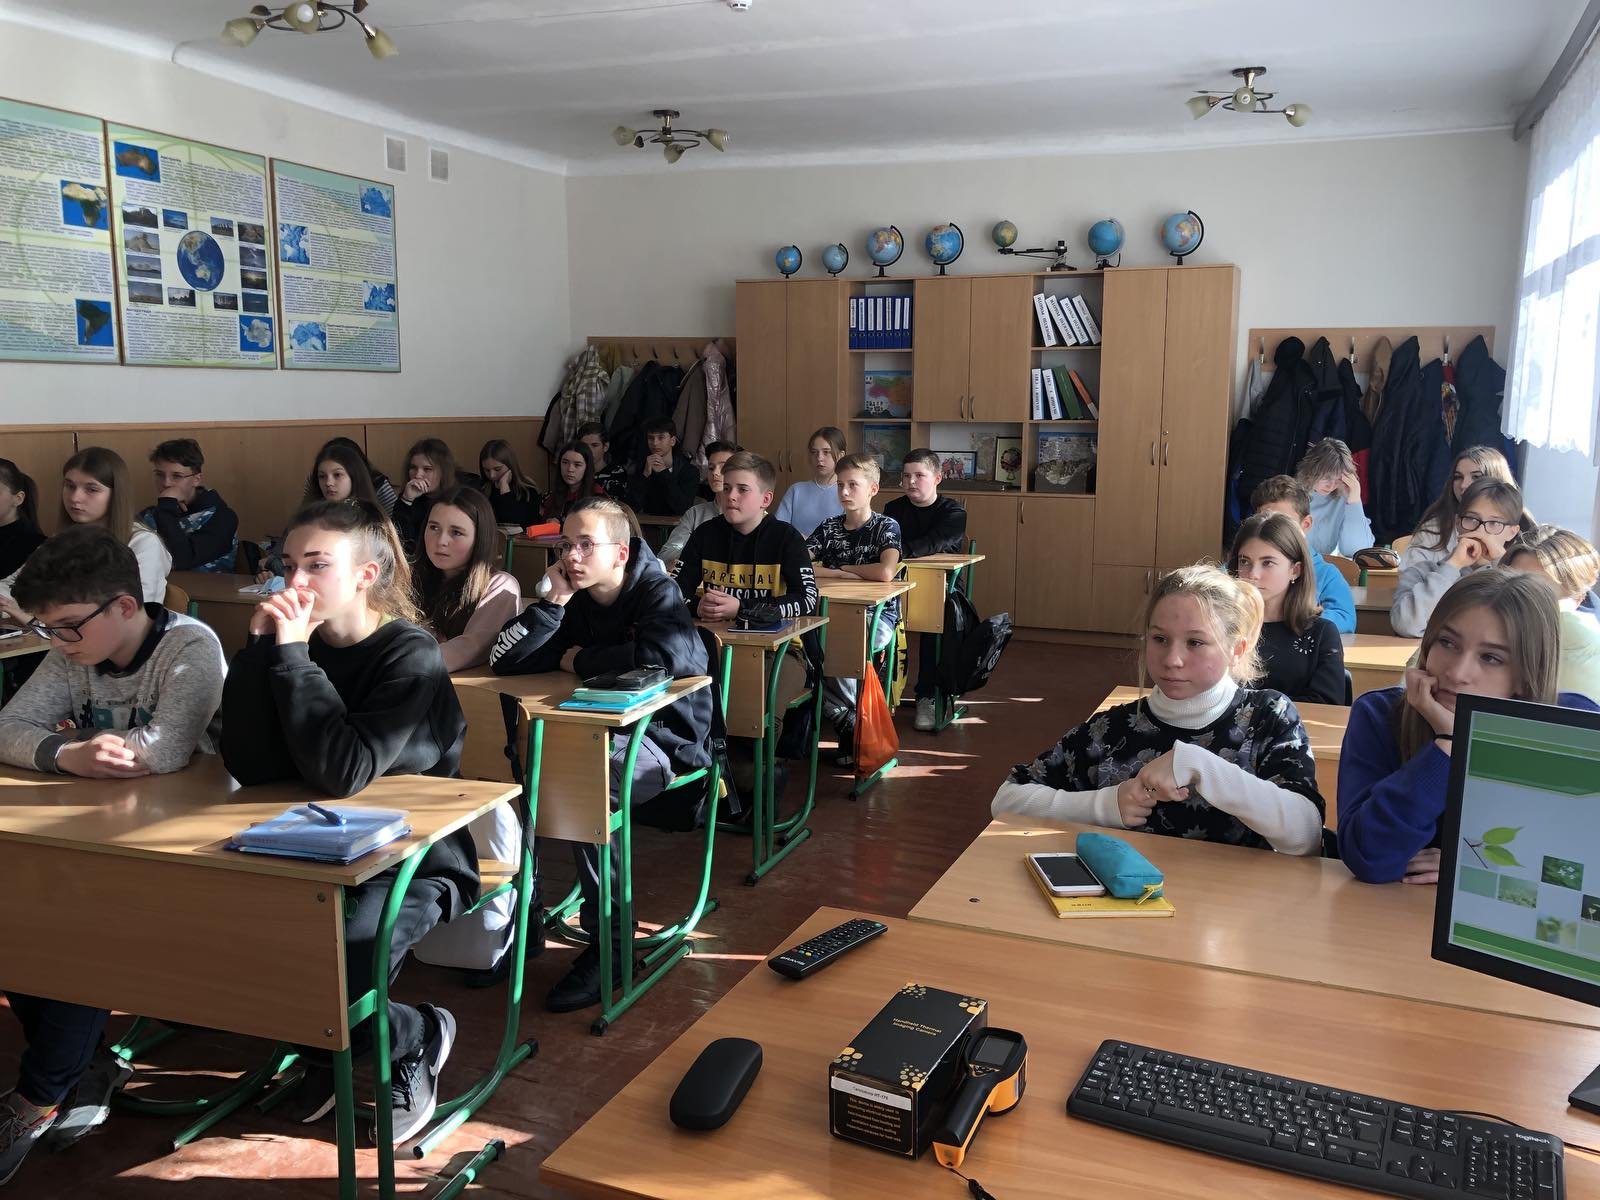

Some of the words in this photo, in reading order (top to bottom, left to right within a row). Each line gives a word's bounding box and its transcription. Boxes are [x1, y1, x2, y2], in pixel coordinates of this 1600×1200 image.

[703, 568, 774, 585] PARENTAL
[915, 1027, 937, 1036] Camera
[920, 1024, 942, 1033] Thermal
[1515, 1133, 1551, 1144] logitech
